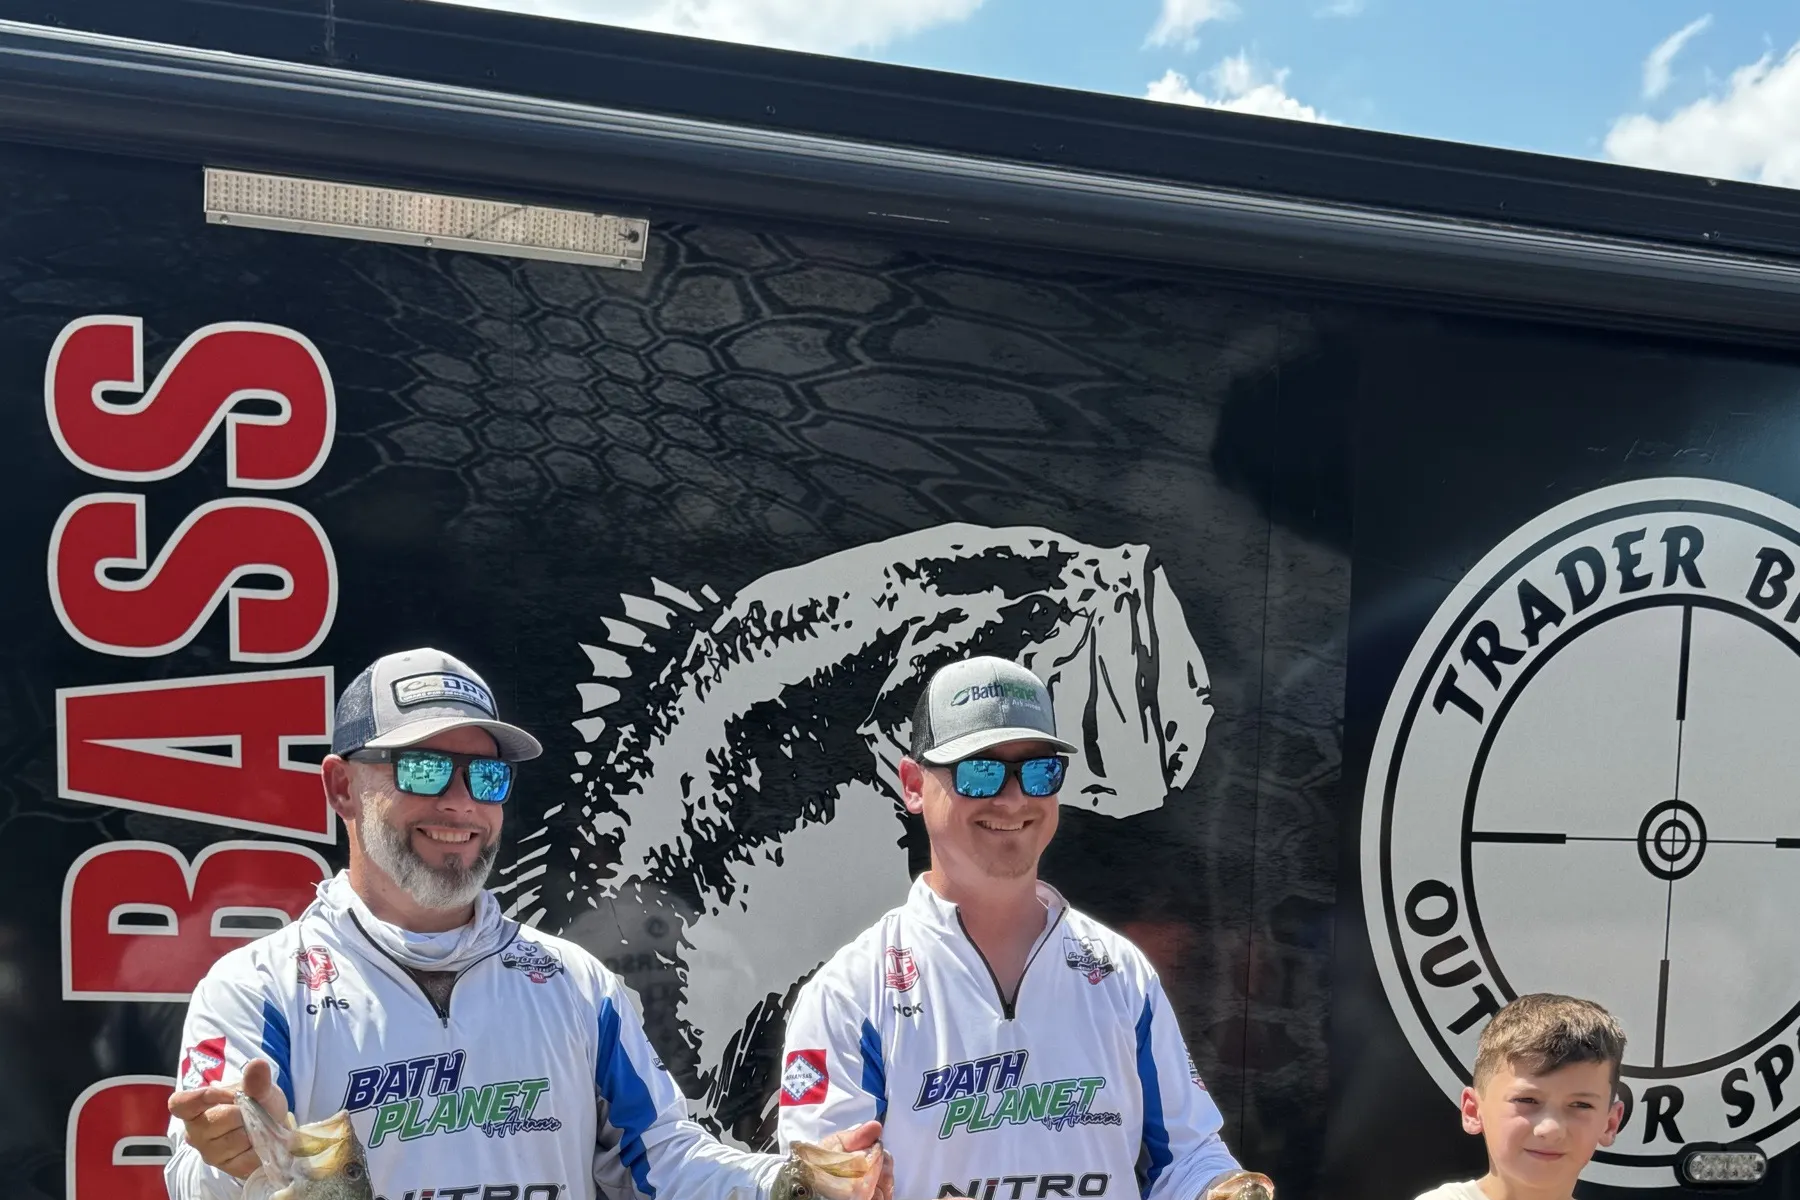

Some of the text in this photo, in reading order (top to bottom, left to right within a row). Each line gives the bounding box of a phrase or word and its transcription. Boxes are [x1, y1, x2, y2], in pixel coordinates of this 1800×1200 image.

[44, 314, 338, 1003] BASS
[1432, 525, 1706, 724] TRADER
[340, 1049, 466, 1113] BATH
[913, 1049, 1028, 1111] BATH
[938, 1077, 1106, 1140] PLANET
[1719, 1026, 1800, 1129] SP
[368, 1078, 550, 1148] PLANET
